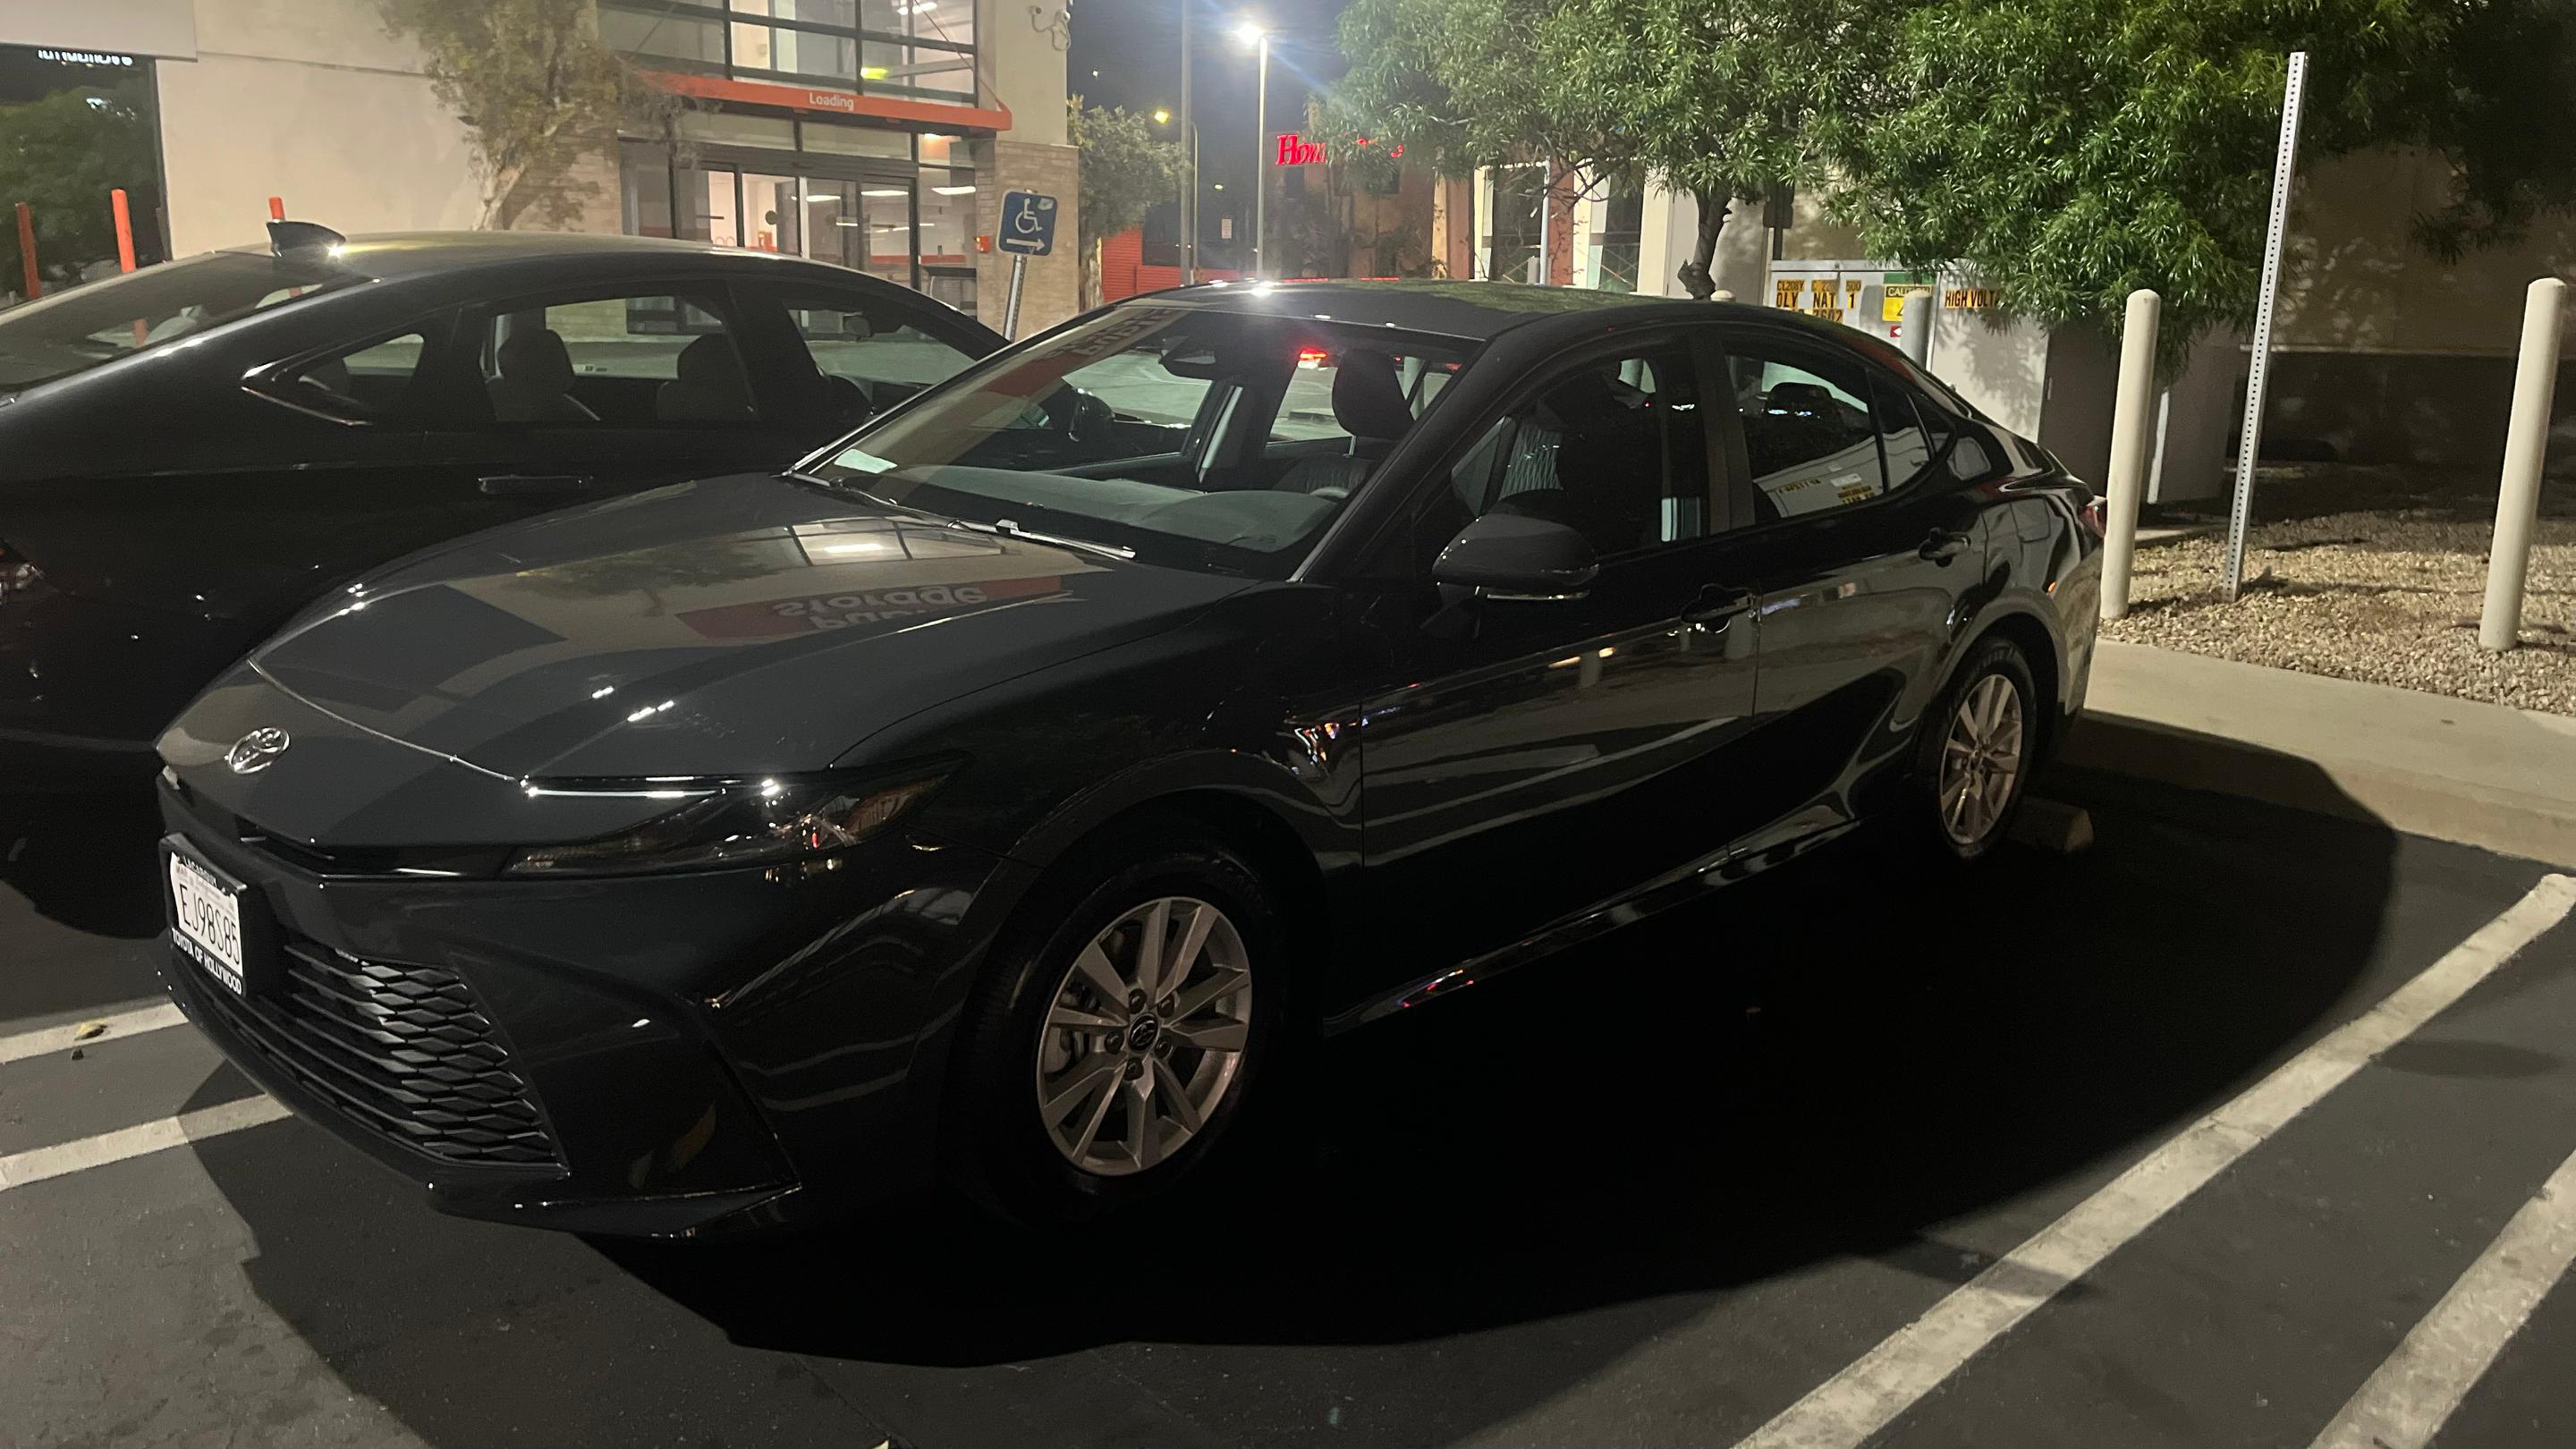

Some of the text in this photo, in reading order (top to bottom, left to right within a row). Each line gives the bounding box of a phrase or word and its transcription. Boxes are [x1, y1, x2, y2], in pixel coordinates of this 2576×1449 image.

[809, 92, 854, 112] Loading
[1776, 292, 1855, 309] OLY NAT 1
[1945, 290, 2000, 307] HIGH VOLT
[180, 884, 240, 965] EJ98S85
[172, 927, 242, 996] TOYOTA OF HOLLYWOOD
